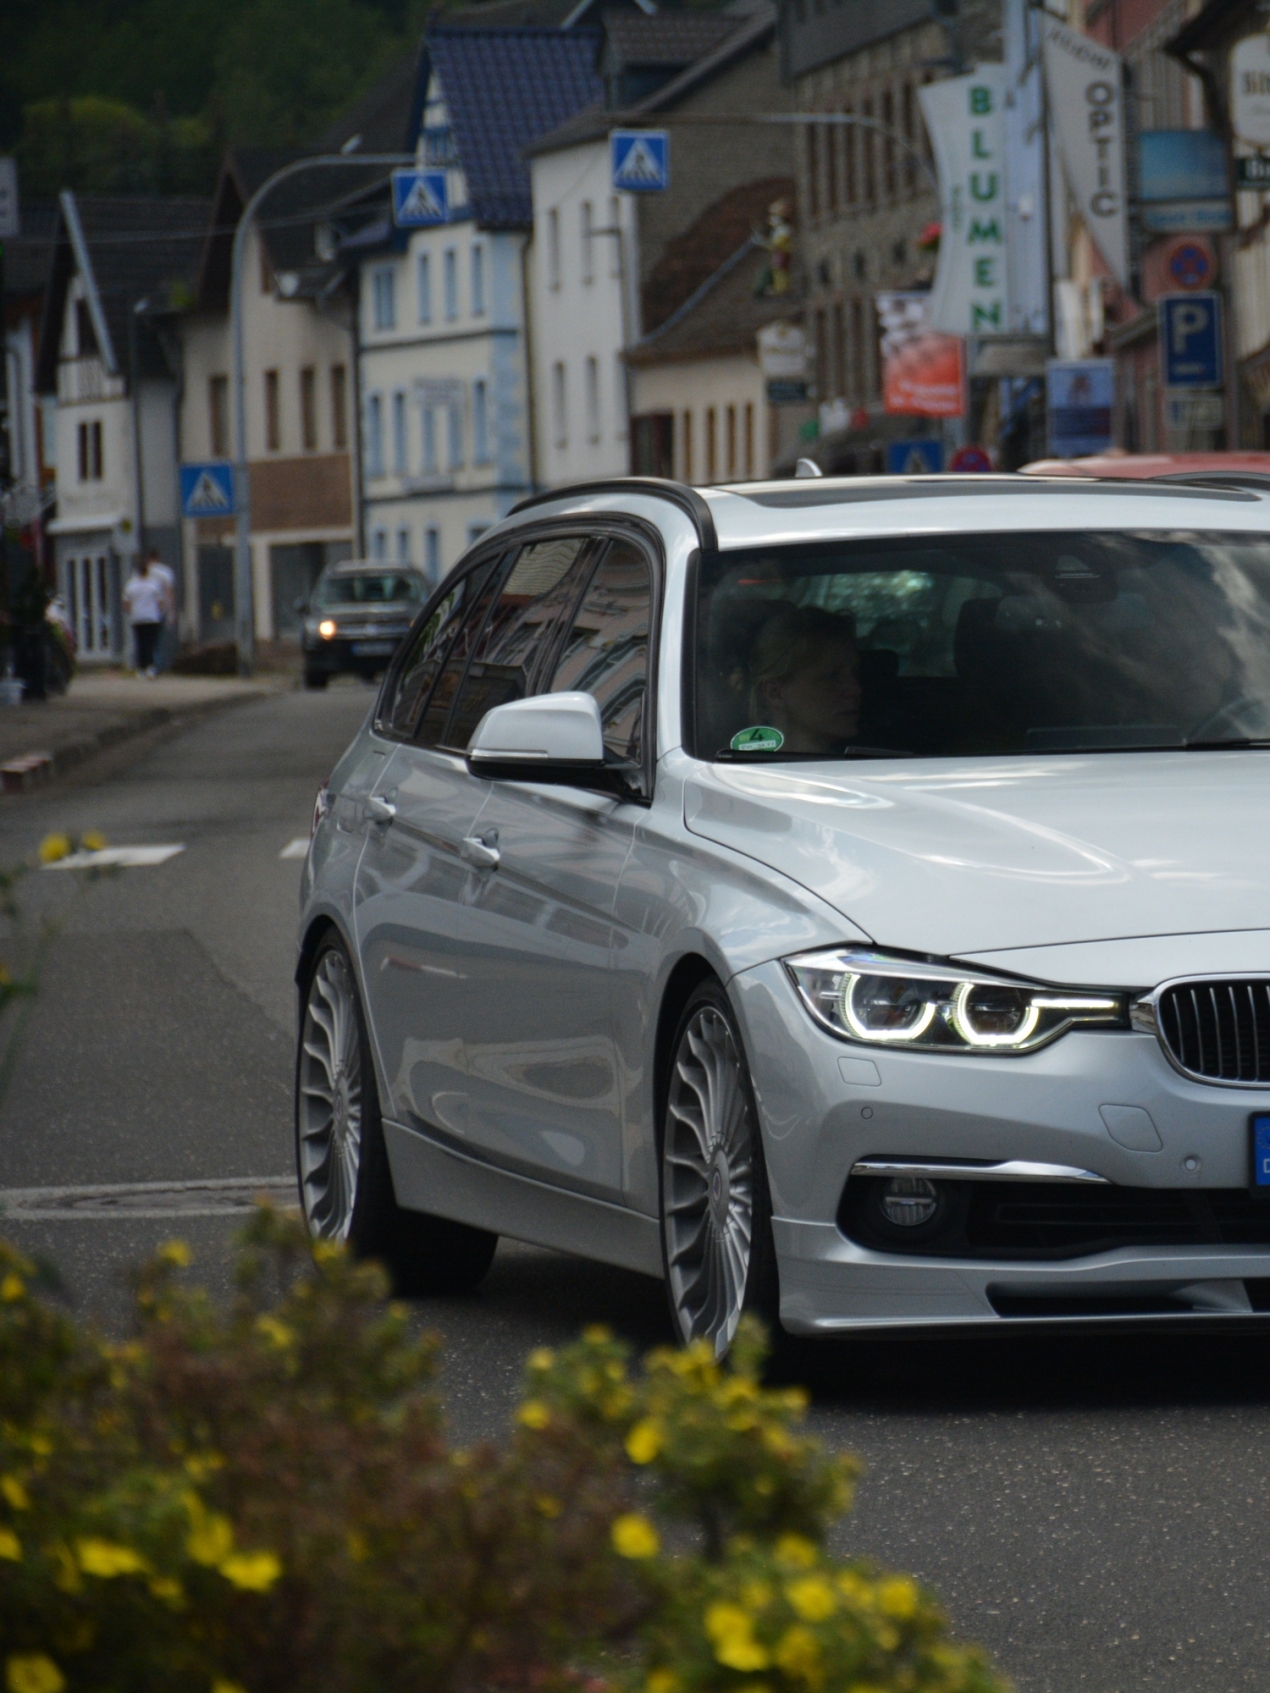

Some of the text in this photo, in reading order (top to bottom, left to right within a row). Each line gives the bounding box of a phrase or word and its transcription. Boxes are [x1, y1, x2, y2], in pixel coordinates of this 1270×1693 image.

[1085, 80, 1119, 218] OPTIC
[968, 85, 1002, 334] BLUMEN
[1173, 303, 1208, 354] P
[749, 728, 764, 742] 4
